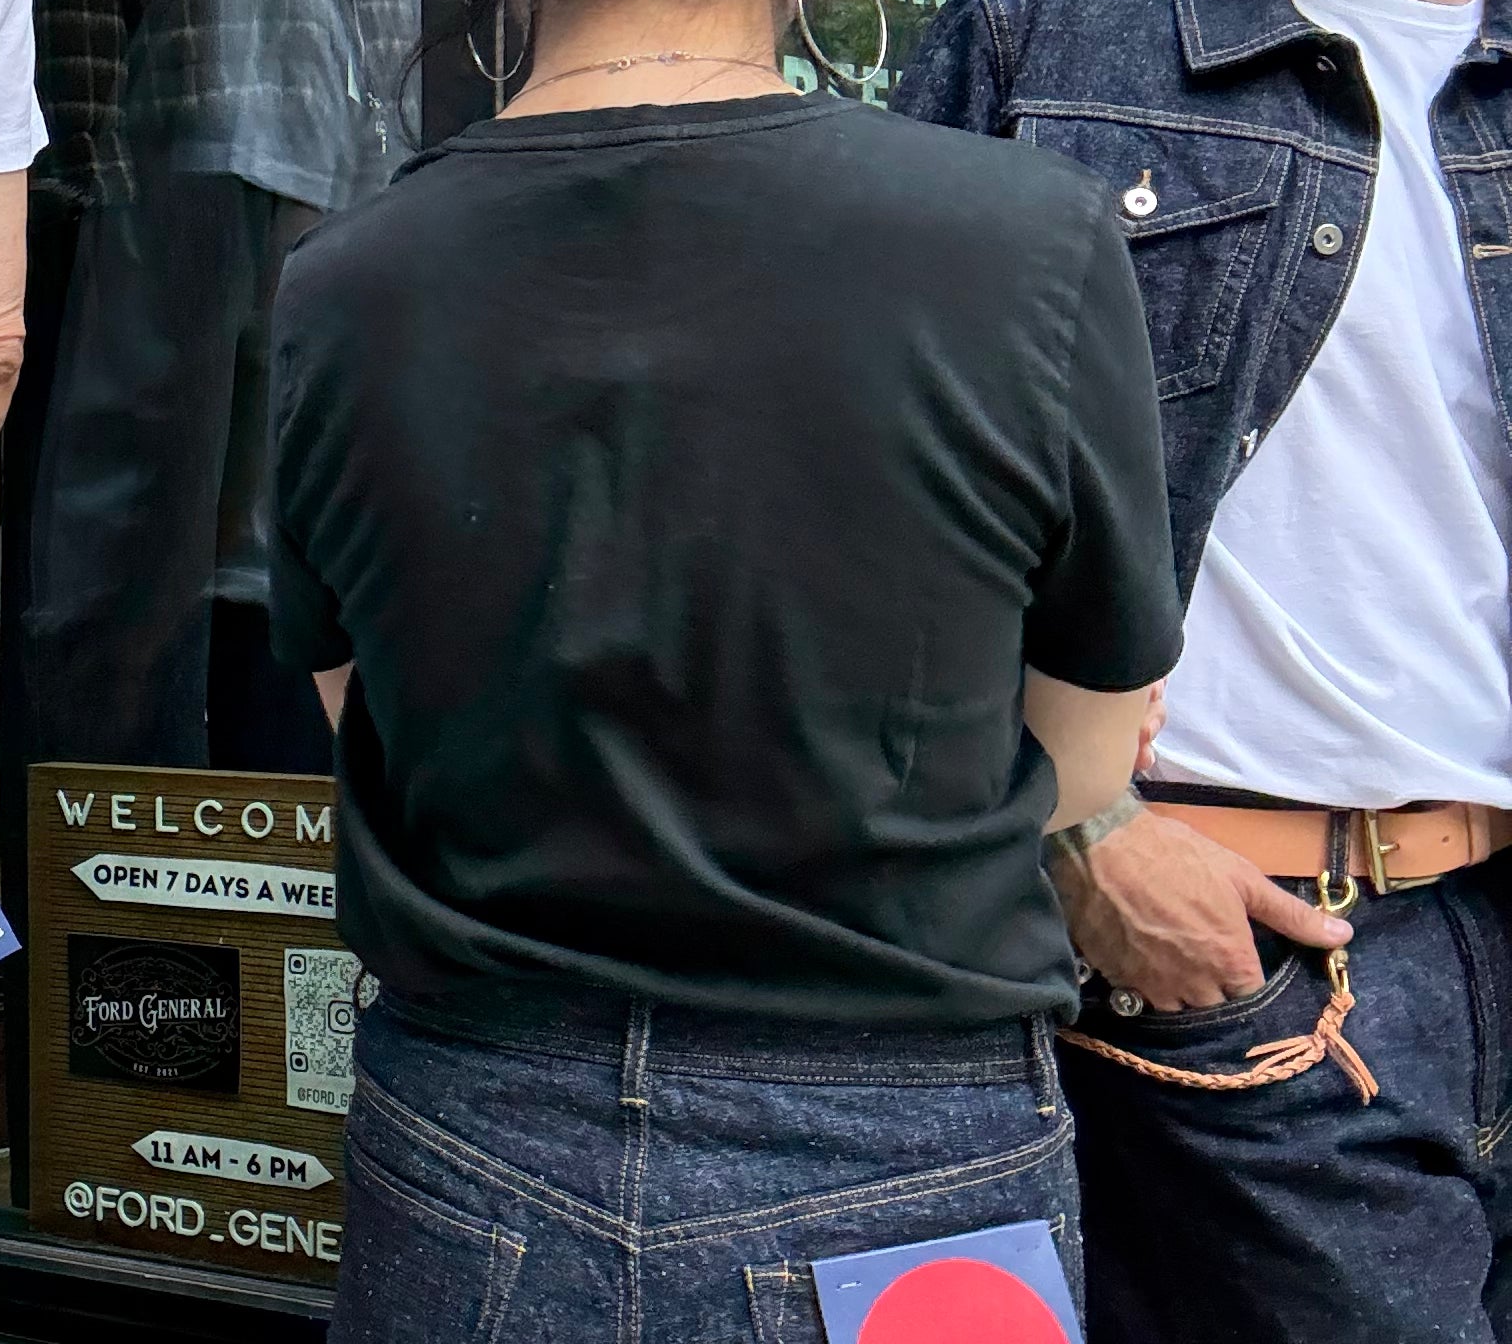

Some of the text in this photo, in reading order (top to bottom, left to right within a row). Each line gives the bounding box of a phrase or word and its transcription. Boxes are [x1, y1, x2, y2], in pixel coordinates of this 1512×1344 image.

[56, 788, 332, 844] WELCOM
[93, 864, 336, 908] OPEN 7 DAYS A WEE
[83, 992, 228, 1034] FORD GENERAL
[297, 1087, 354, 1109] @FORD_G
[150, 1140, 175, 1165] 11
[181, 1144, 222, 1170] AM
[246, 1153, 262, 1176] 6
[270, 1156, 308, 1183] PM
[63, 1180, 343, 1263] @FORD_GENE
